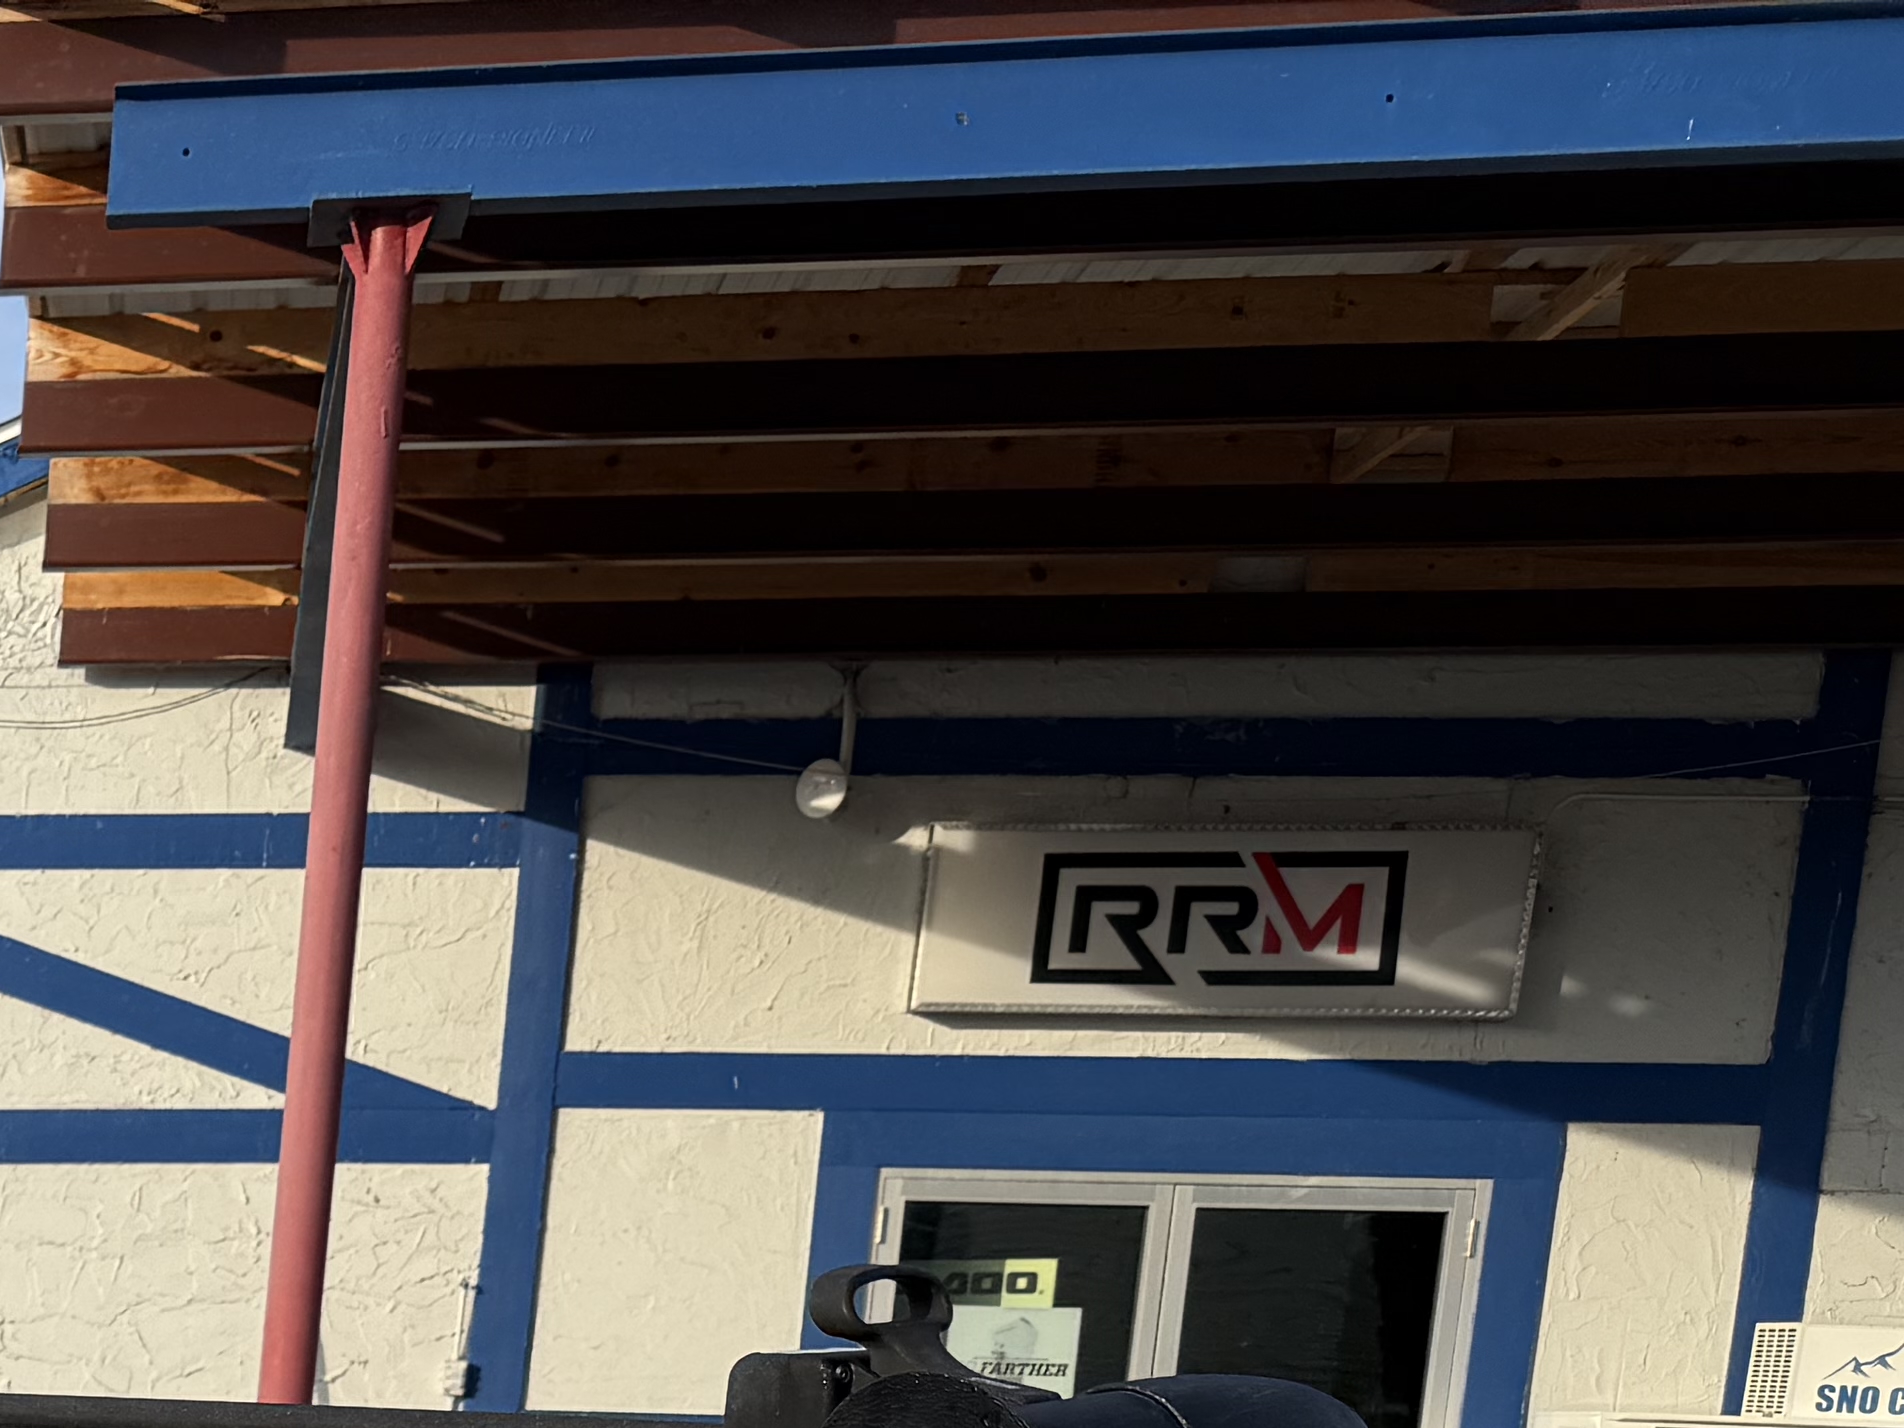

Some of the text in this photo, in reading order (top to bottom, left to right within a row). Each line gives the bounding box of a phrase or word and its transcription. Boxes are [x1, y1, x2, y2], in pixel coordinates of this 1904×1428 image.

[1068, 852, 1365, 956] RRM
[980, 1361, 1069, 1377] FARTHER
[1815, 1384, 1880, 1414] SNO
